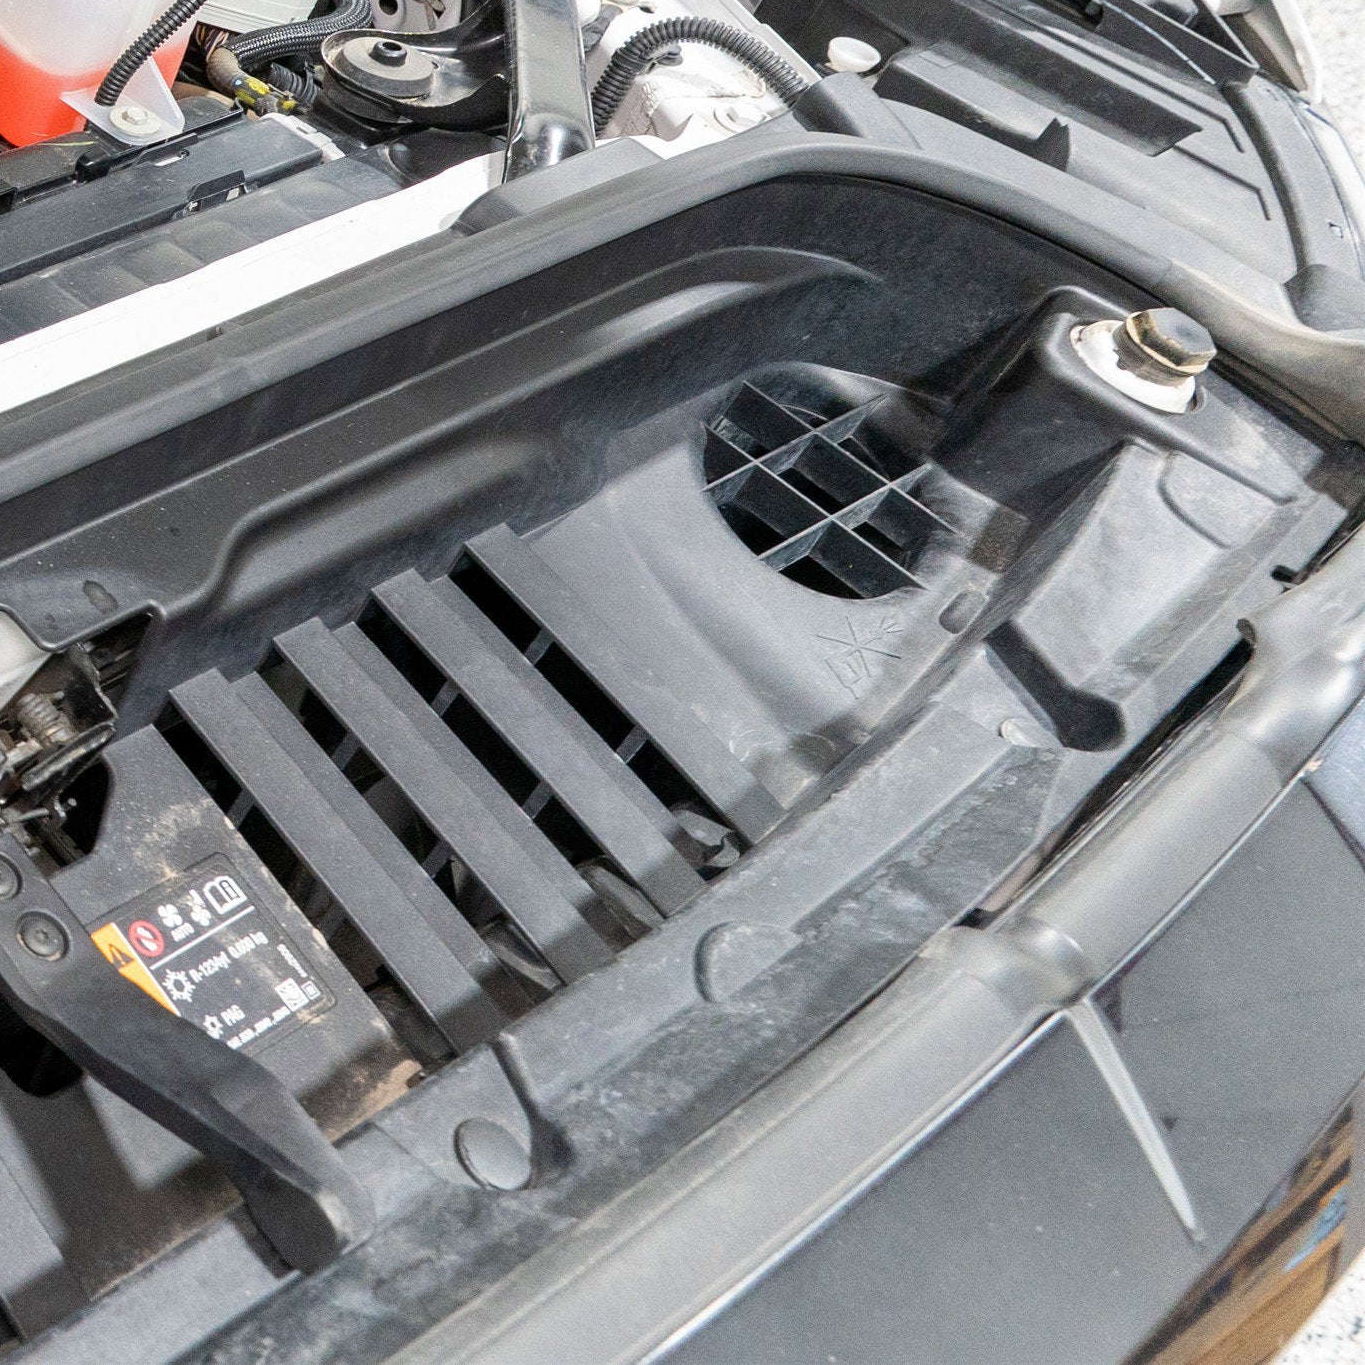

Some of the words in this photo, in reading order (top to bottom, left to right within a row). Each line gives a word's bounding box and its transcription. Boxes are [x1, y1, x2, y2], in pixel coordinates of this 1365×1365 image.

[171, 922, 195, 942] AUTO
[249, 931, 268, 945] kg
[220, 1004, 246, 1026] PAG
